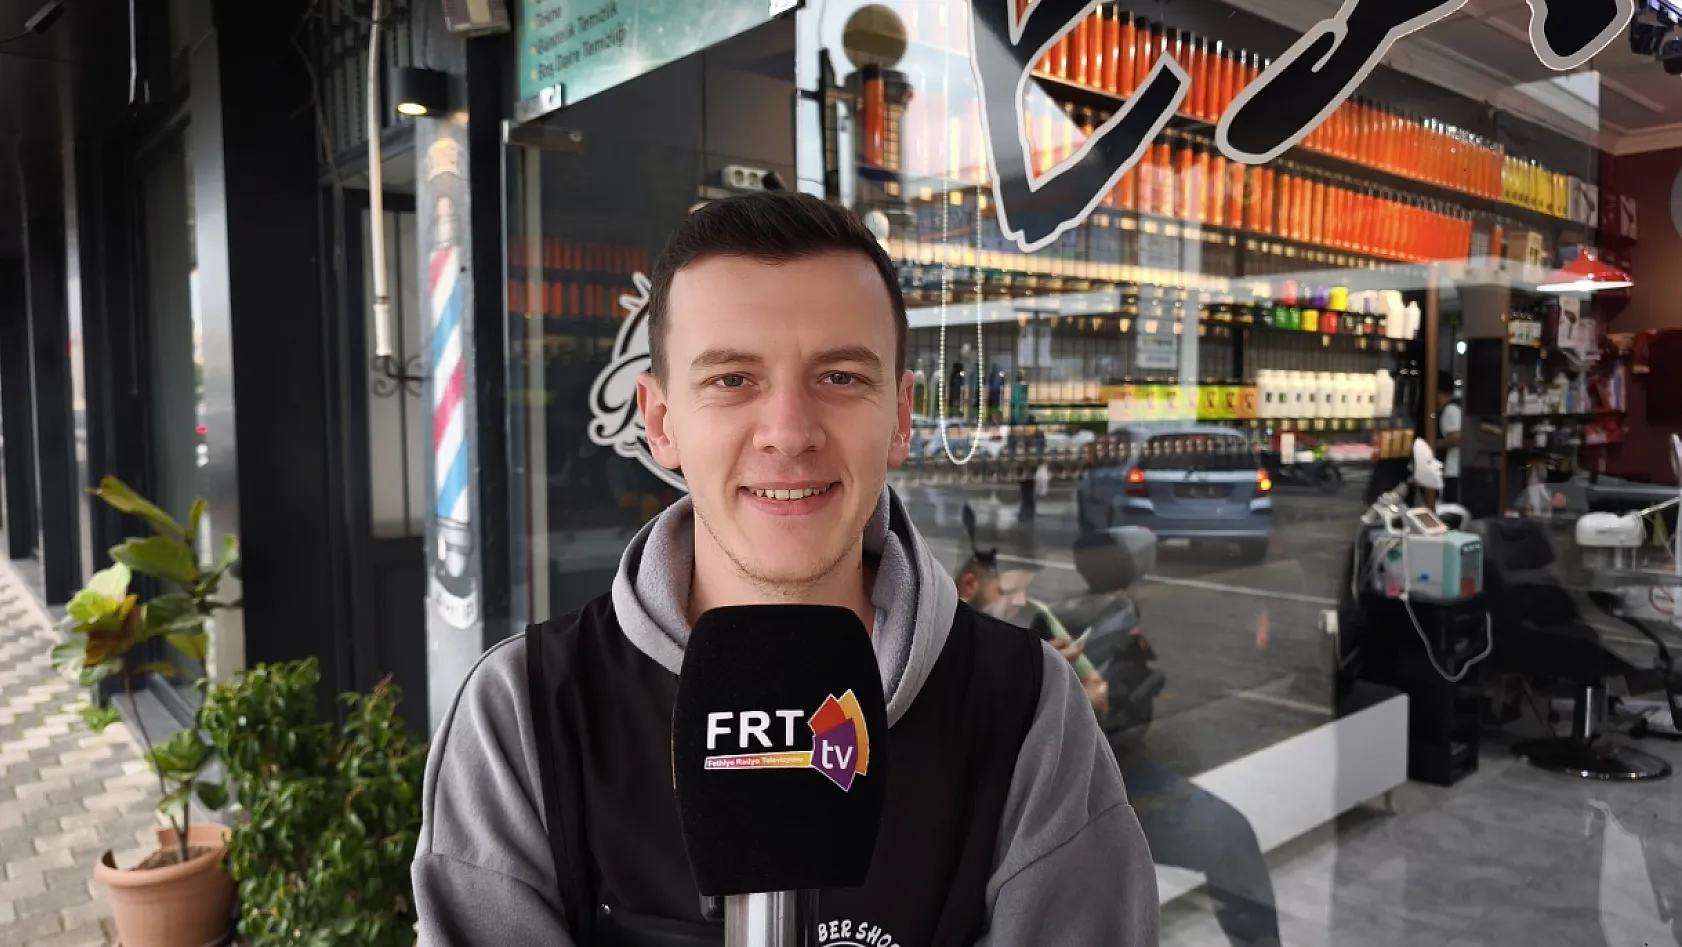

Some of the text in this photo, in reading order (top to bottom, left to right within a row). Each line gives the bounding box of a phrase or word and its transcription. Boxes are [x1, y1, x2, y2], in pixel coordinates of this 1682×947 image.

[706, 710, 804, 750] FRT
[708, 759, 735, 768] Fethiye
[735, 757, 760, 767] Radyo
[821, 739, 853, 770] tv
[855, 921, 900, 947] SHO
